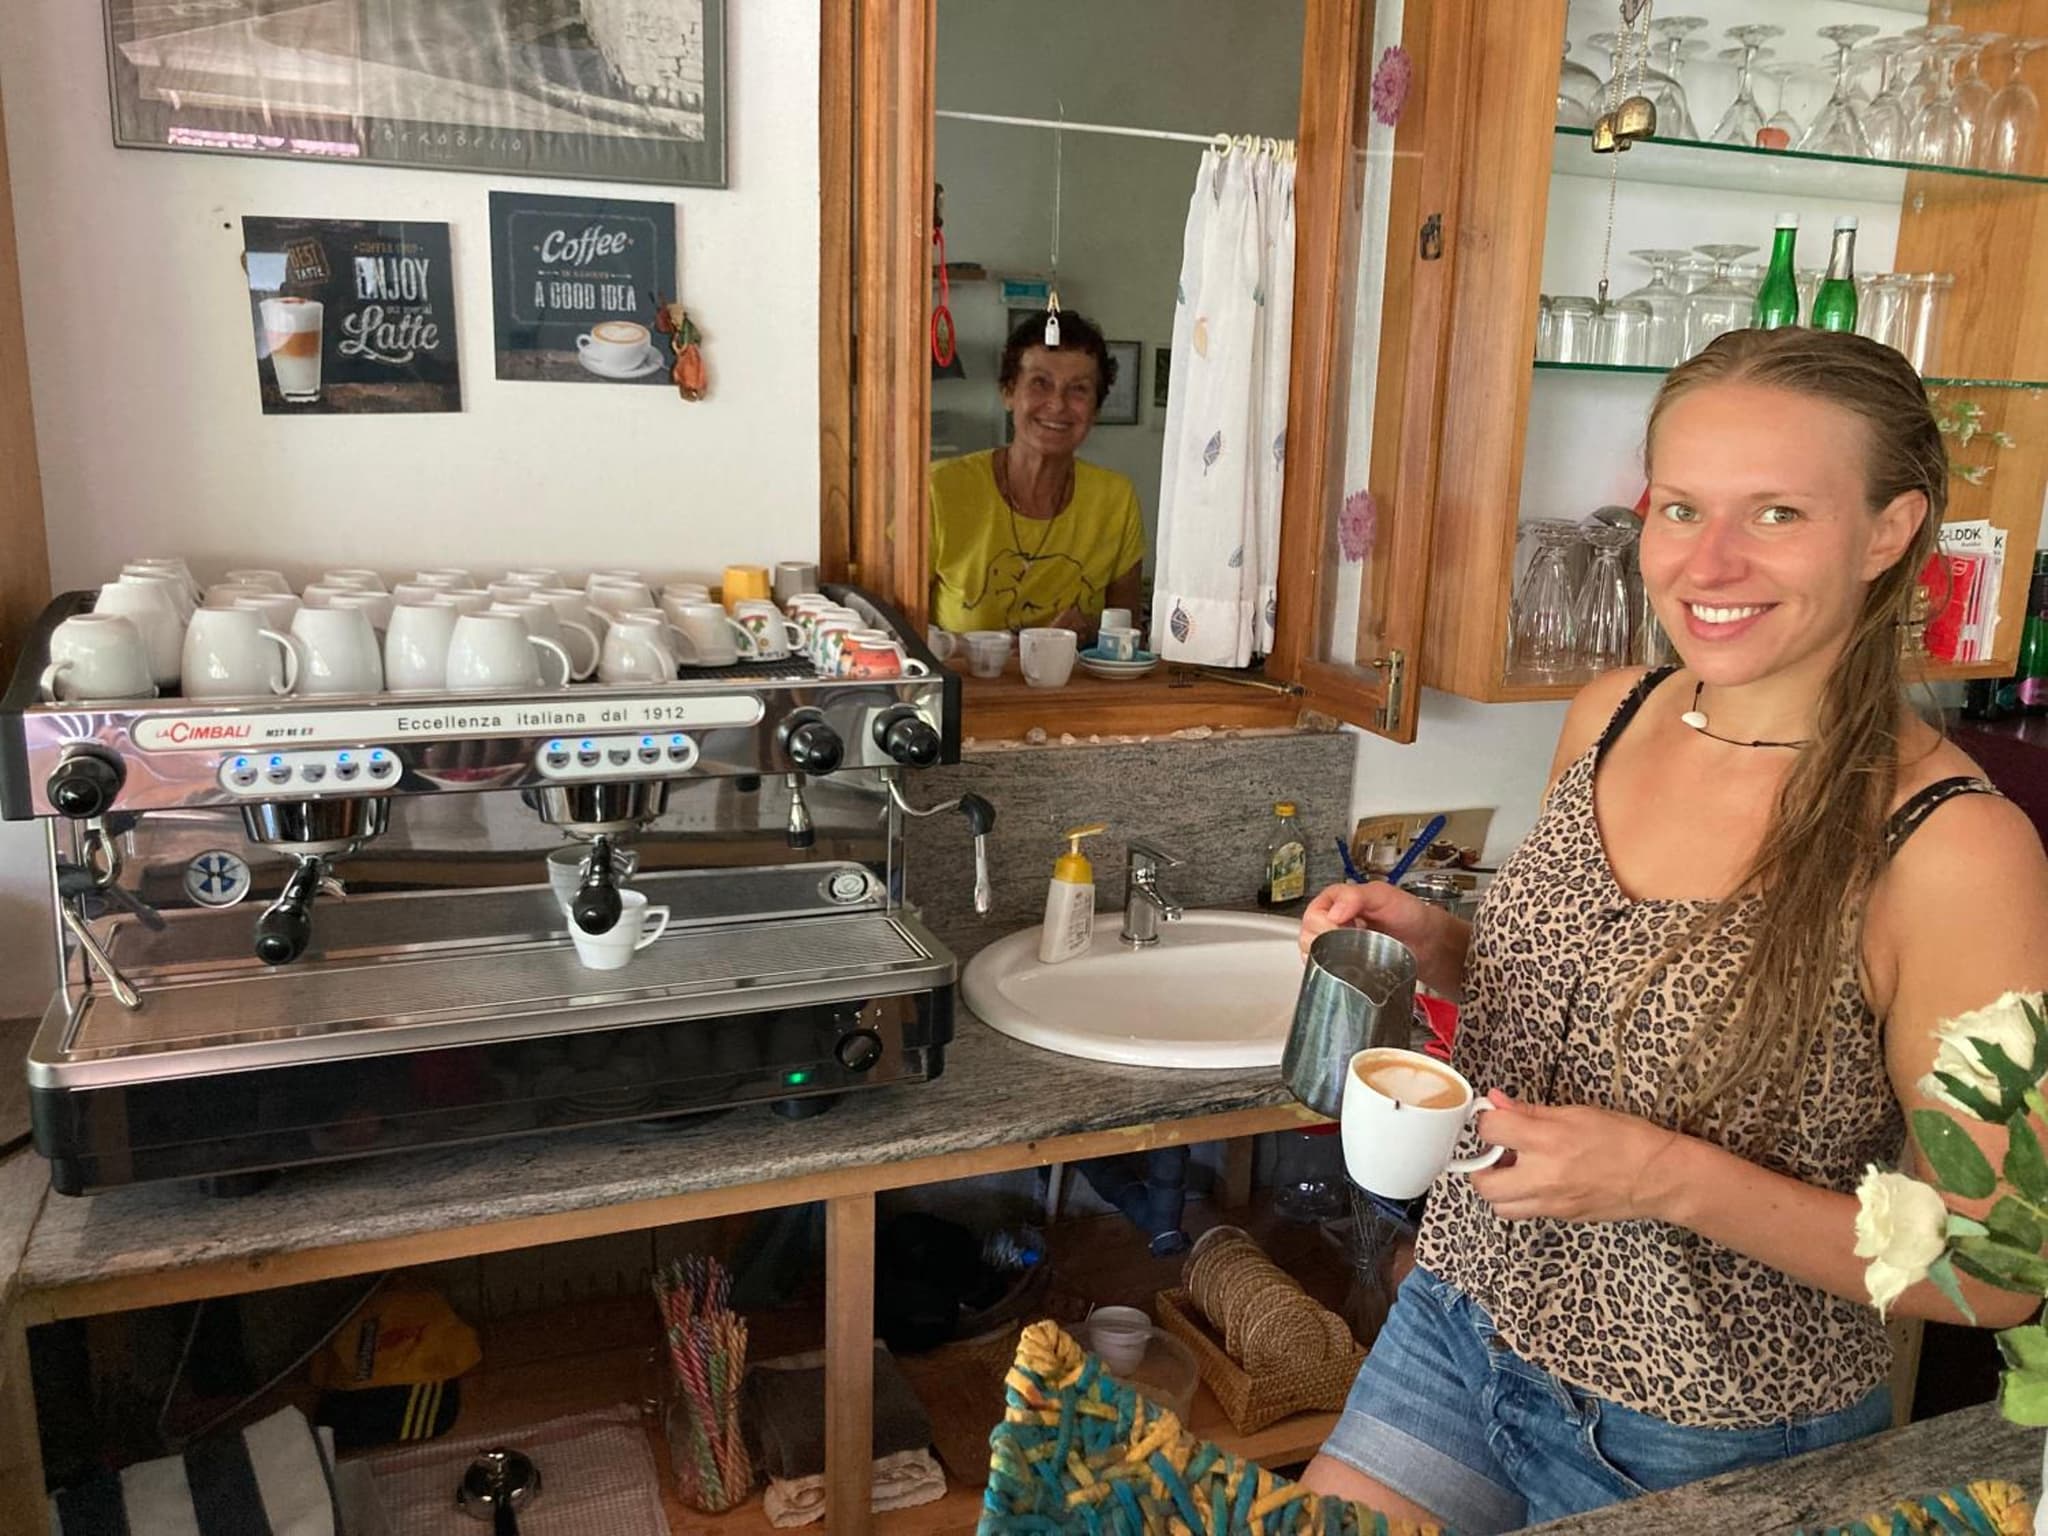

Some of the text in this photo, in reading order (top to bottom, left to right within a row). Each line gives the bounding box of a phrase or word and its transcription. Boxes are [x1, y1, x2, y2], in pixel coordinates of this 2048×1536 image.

[288, 243, 319, 269] BEST
[541, 224, 628, 266] Coffee
[354, 256, 430, 301] ENJOY
[535, 281, 637, 312] A GOOD IDEA
[339, 304, 440, 363] Latte
[170, 722, 252, 743] CIMBALI
[397, 706, 685, 731] Eccellenza italiana dal 1912
